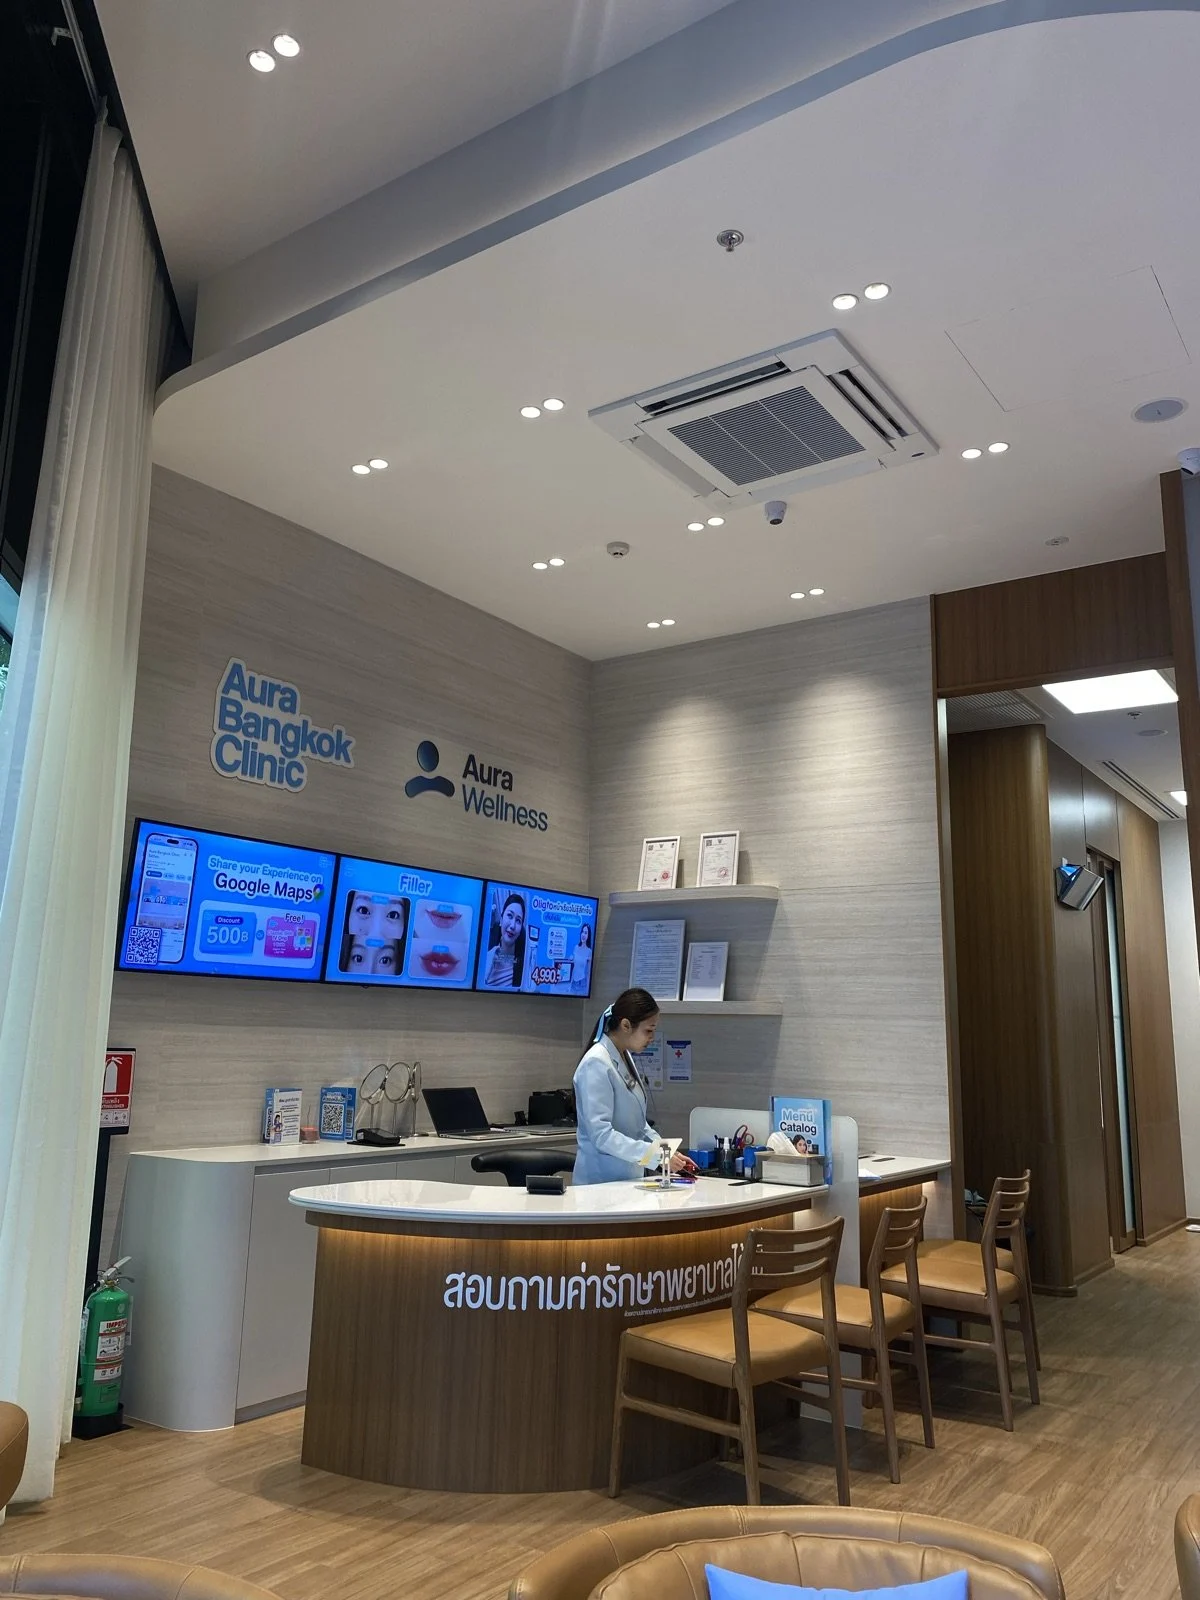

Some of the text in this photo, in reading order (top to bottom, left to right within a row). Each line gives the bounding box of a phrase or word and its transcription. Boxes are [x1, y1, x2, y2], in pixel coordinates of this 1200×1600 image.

[221, 662, 298, 715] Aura
[218, 695, 353, 763] Bangkok
[214, 733, 305, 788] Clinic
[462, 753, 513, 792] Aura
[462, 783, 548, 832] Wellness
[209, 857, 322, 884] Share your Experience on
[400, 875, 431, 894] Filler
[215, 872, 313, 902] Google Maps
[285, 912, 305, 924] Free!
[780, 1121, 817, 1136] Catalog
[782, 1109, 813, 1122] Menu
